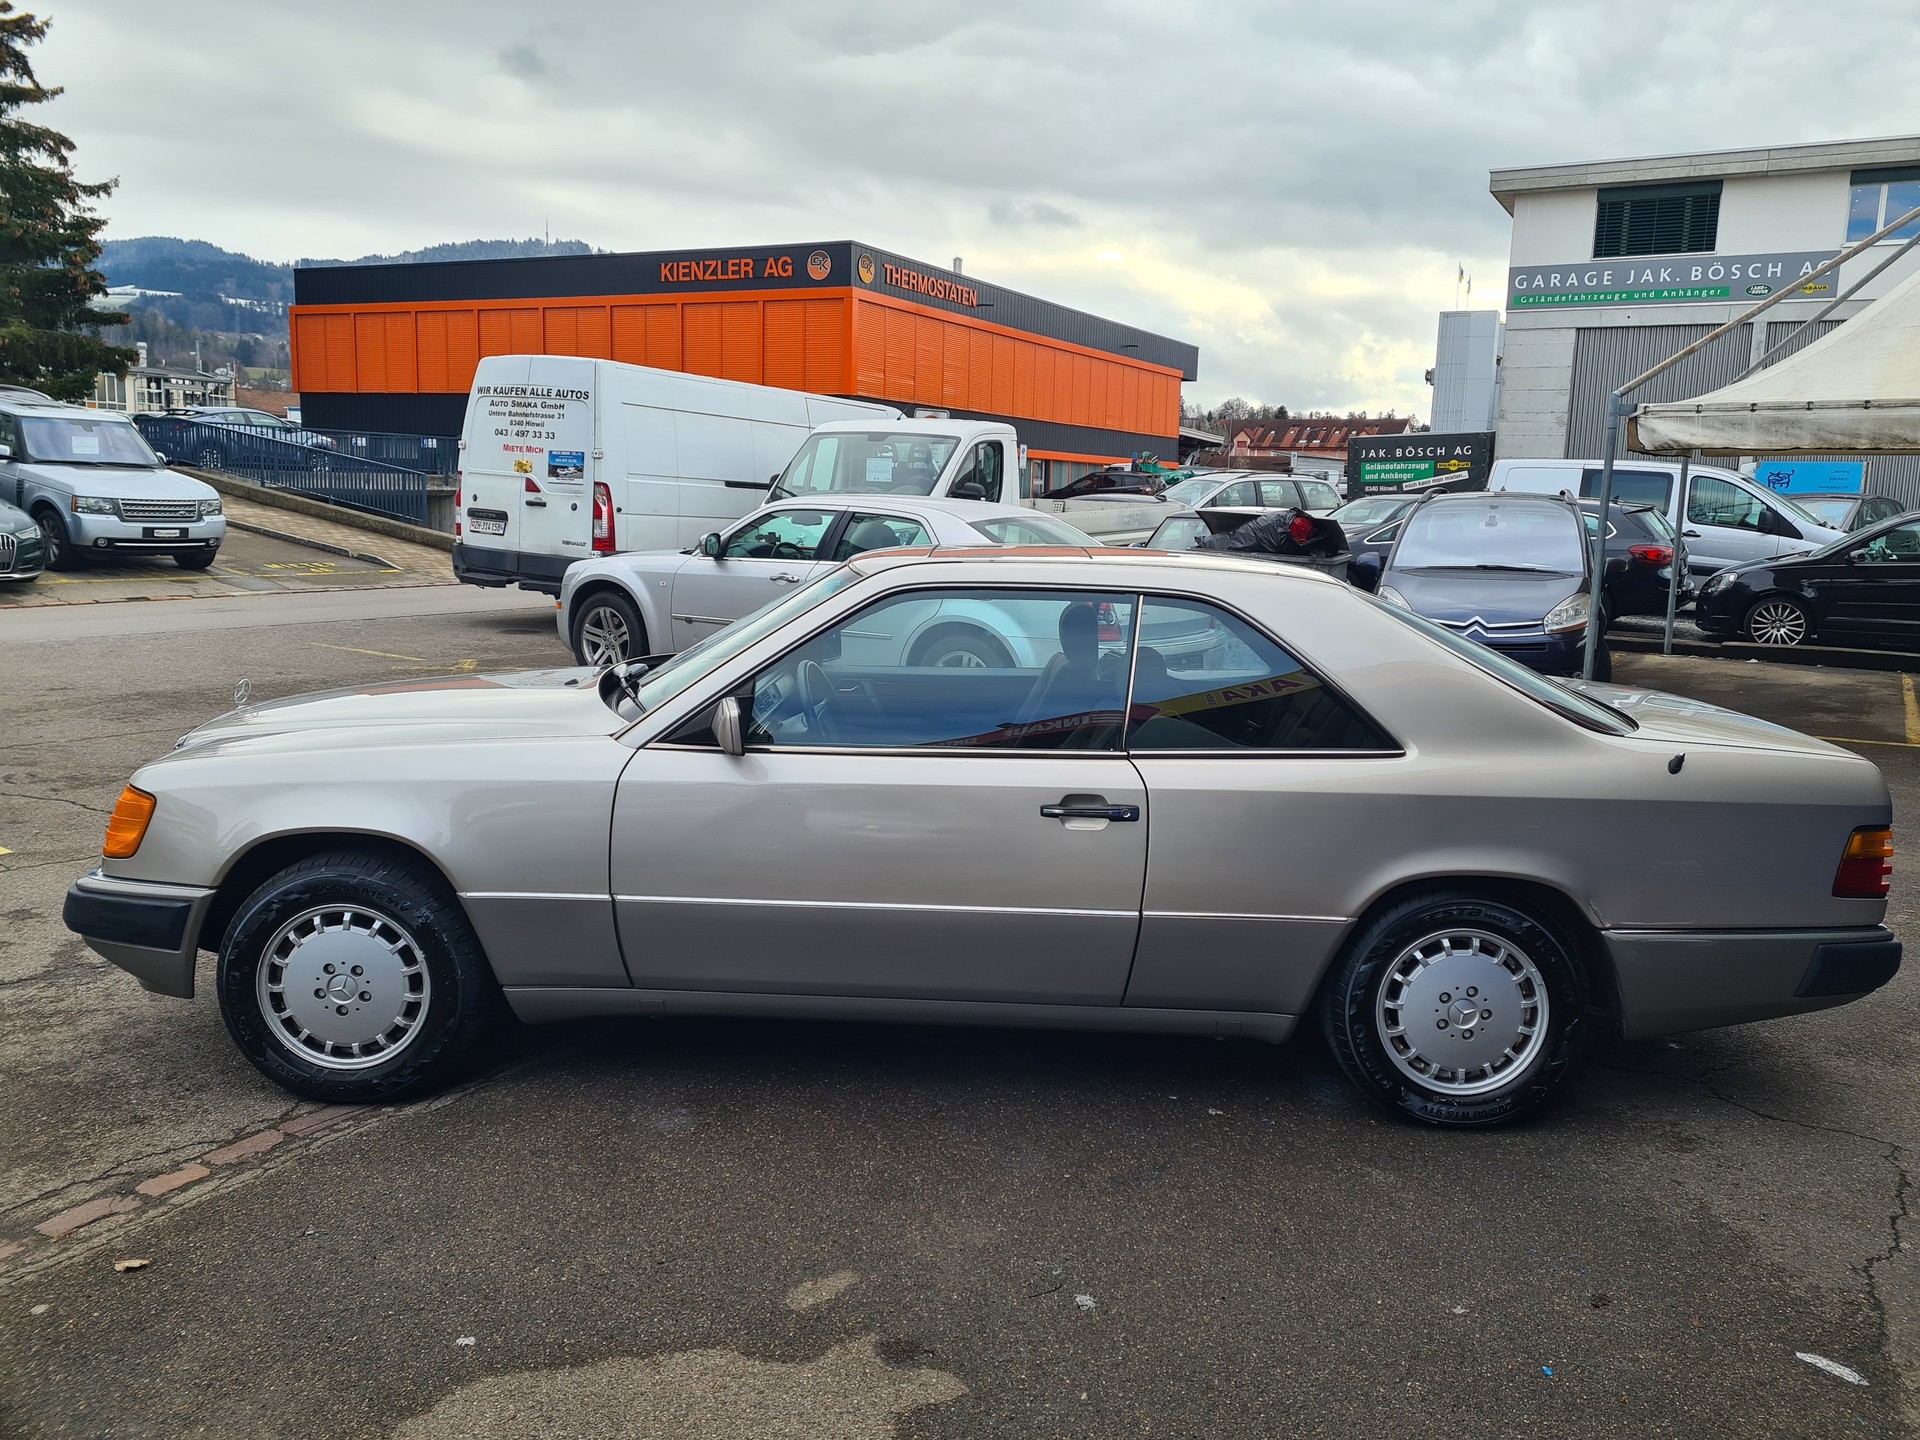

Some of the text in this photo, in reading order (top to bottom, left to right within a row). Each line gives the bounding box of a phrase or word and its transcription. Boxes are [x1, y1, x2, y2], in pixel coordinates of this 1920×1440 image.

[660, 256, 793, 282] KIENZLER AG
[1514, 270, 1613, 290] GARAGE
[1627, 266, 1681, 284] JAK.
[1690, 261, 1783, 282] BÖSCH
[882, 262, 977, 308] THERMOSTATEN
[1520, 287, 1722, 304] Geländefahrzeuge und Anhänger
[477, 386, 590, 400] WIR KAUFEN ALLE AUTOS
[540, 401, 565, 410] GmbH
[508, 410, 555, 420] Bahnhofstrasse
[556, 412, 565, 420] 31
[525, 420, 545, 428] Hinwil
[494, 429, 509, 437] 043
[515, 429, 530, 438] 497
[531, 430, 543, 439] 33
[544, 431, 556, 440] 33
[1361, 445, 1472, 458] JAK. BÖSCH AG
[1365, 463, 1430, 471] Geländefahrzeuge
[1380, 472, 1415, 481] Anhänger
[1405, 481, 1418, 489] mich
[1418, 479, 1431, 487] kann
[561, 539, 587, 547] RENAULT
